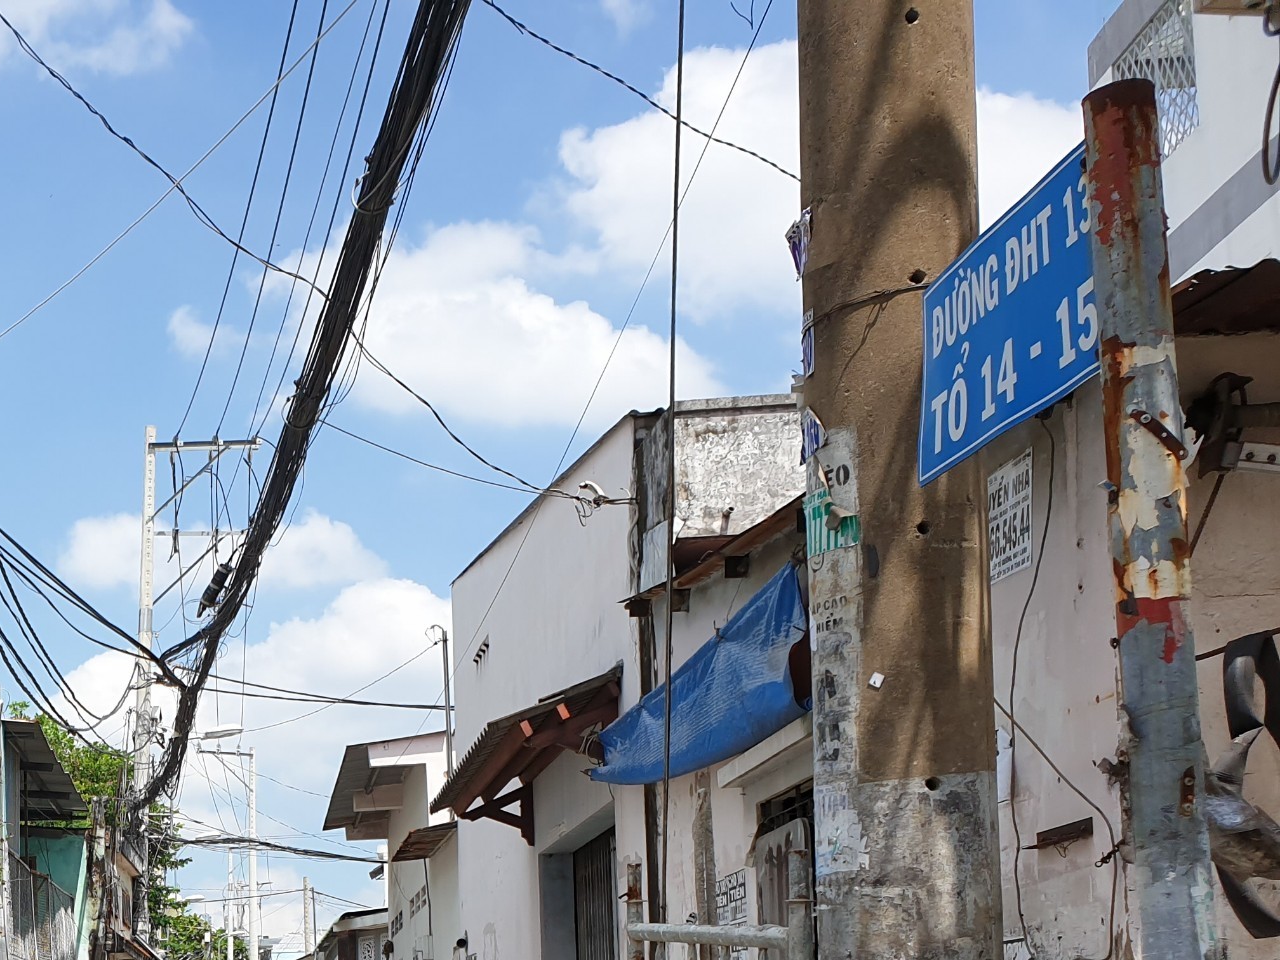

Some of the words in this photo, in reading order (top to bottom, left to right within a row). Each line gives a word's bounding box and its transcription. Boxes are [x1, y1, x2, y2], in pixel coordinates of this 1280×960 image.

[930, 340, 969, 454] TỔ
[980, 337, 1018, 422] 14
[1029, 341, 1041, 359] -
[1055, 275, 1099, 370] 15
[931, 254, 999, 359] ĐƯỜNG
[1004, 204, 1052, 295] ĐHT
